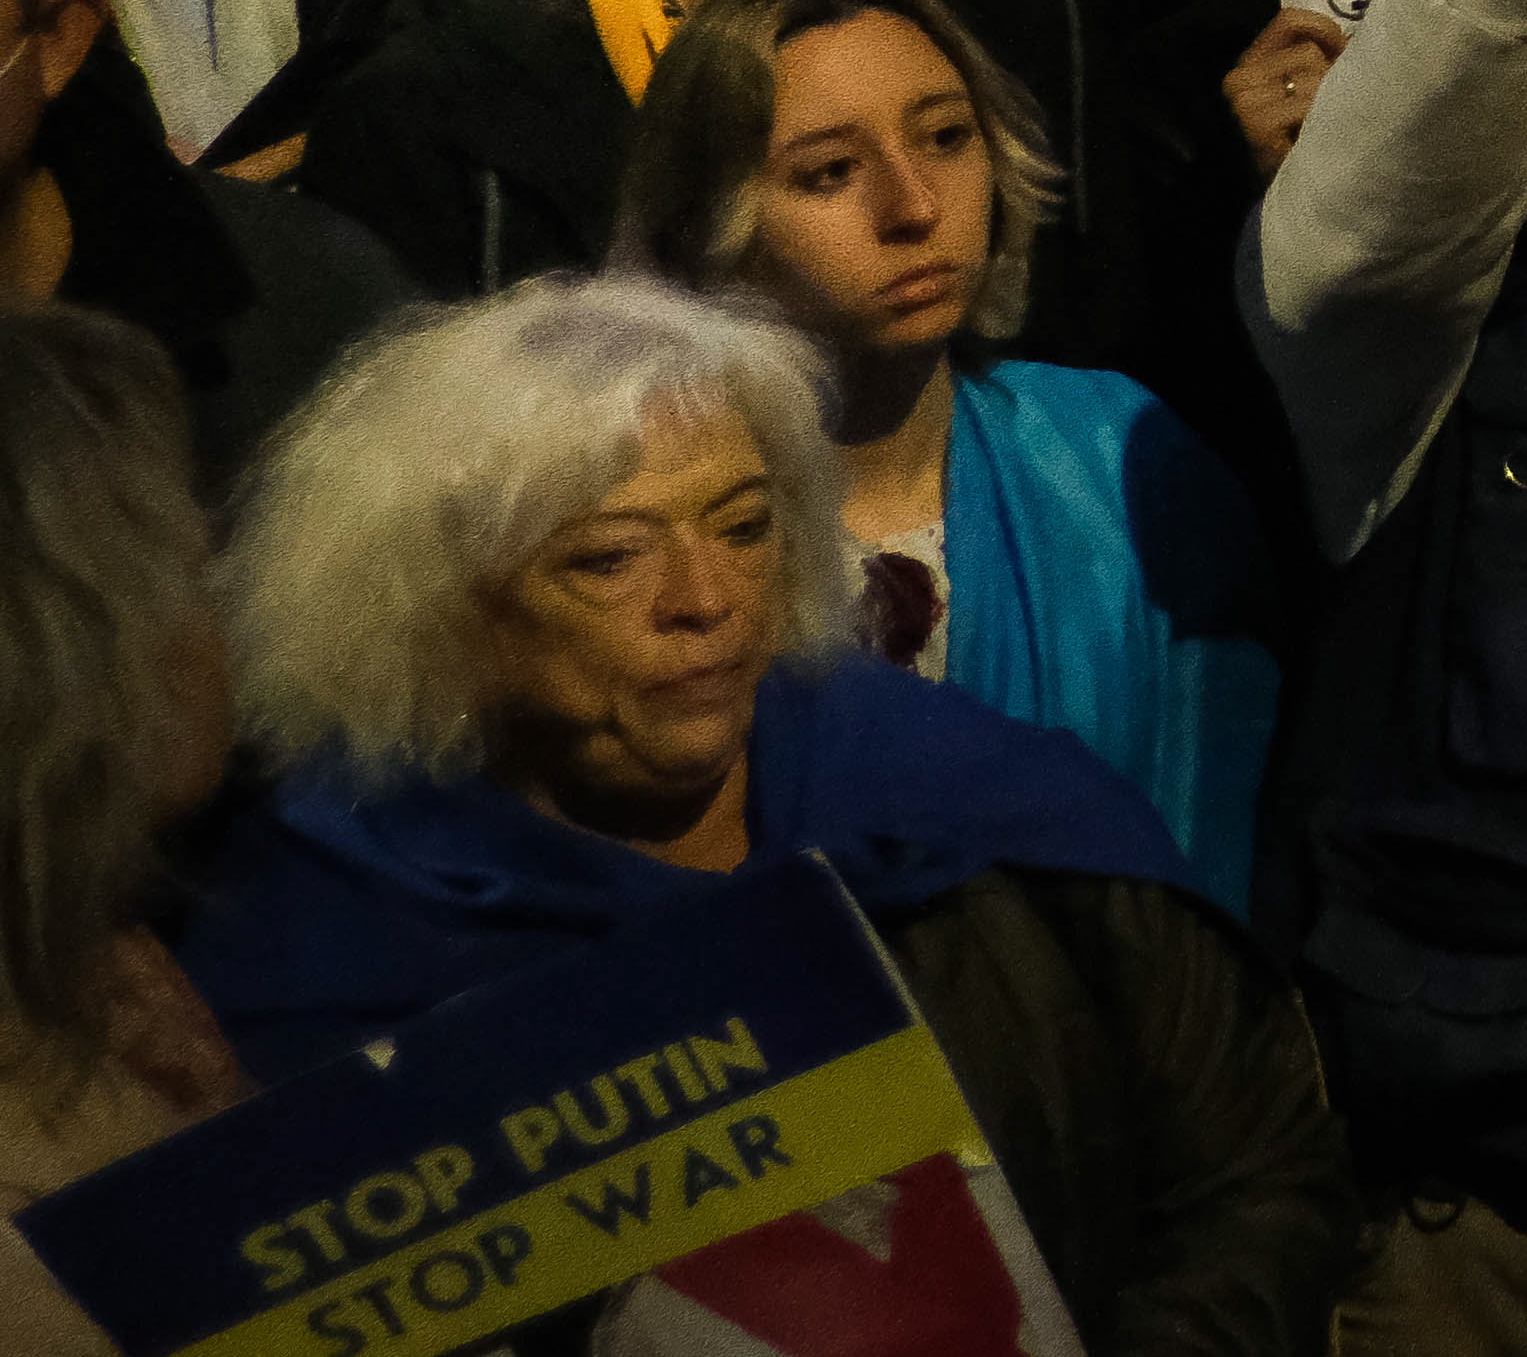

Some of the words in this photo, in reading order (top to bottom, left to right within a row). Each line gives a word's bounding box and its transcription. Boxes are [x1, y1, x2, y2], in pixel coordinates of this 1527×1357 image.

[236, 1142, 477, 1292] STOP
[498, 1015, 769, 1176] PUTIN
[305, 1224, 535, 1357] STOP
[563, 1111, 792, 1240] WAR
